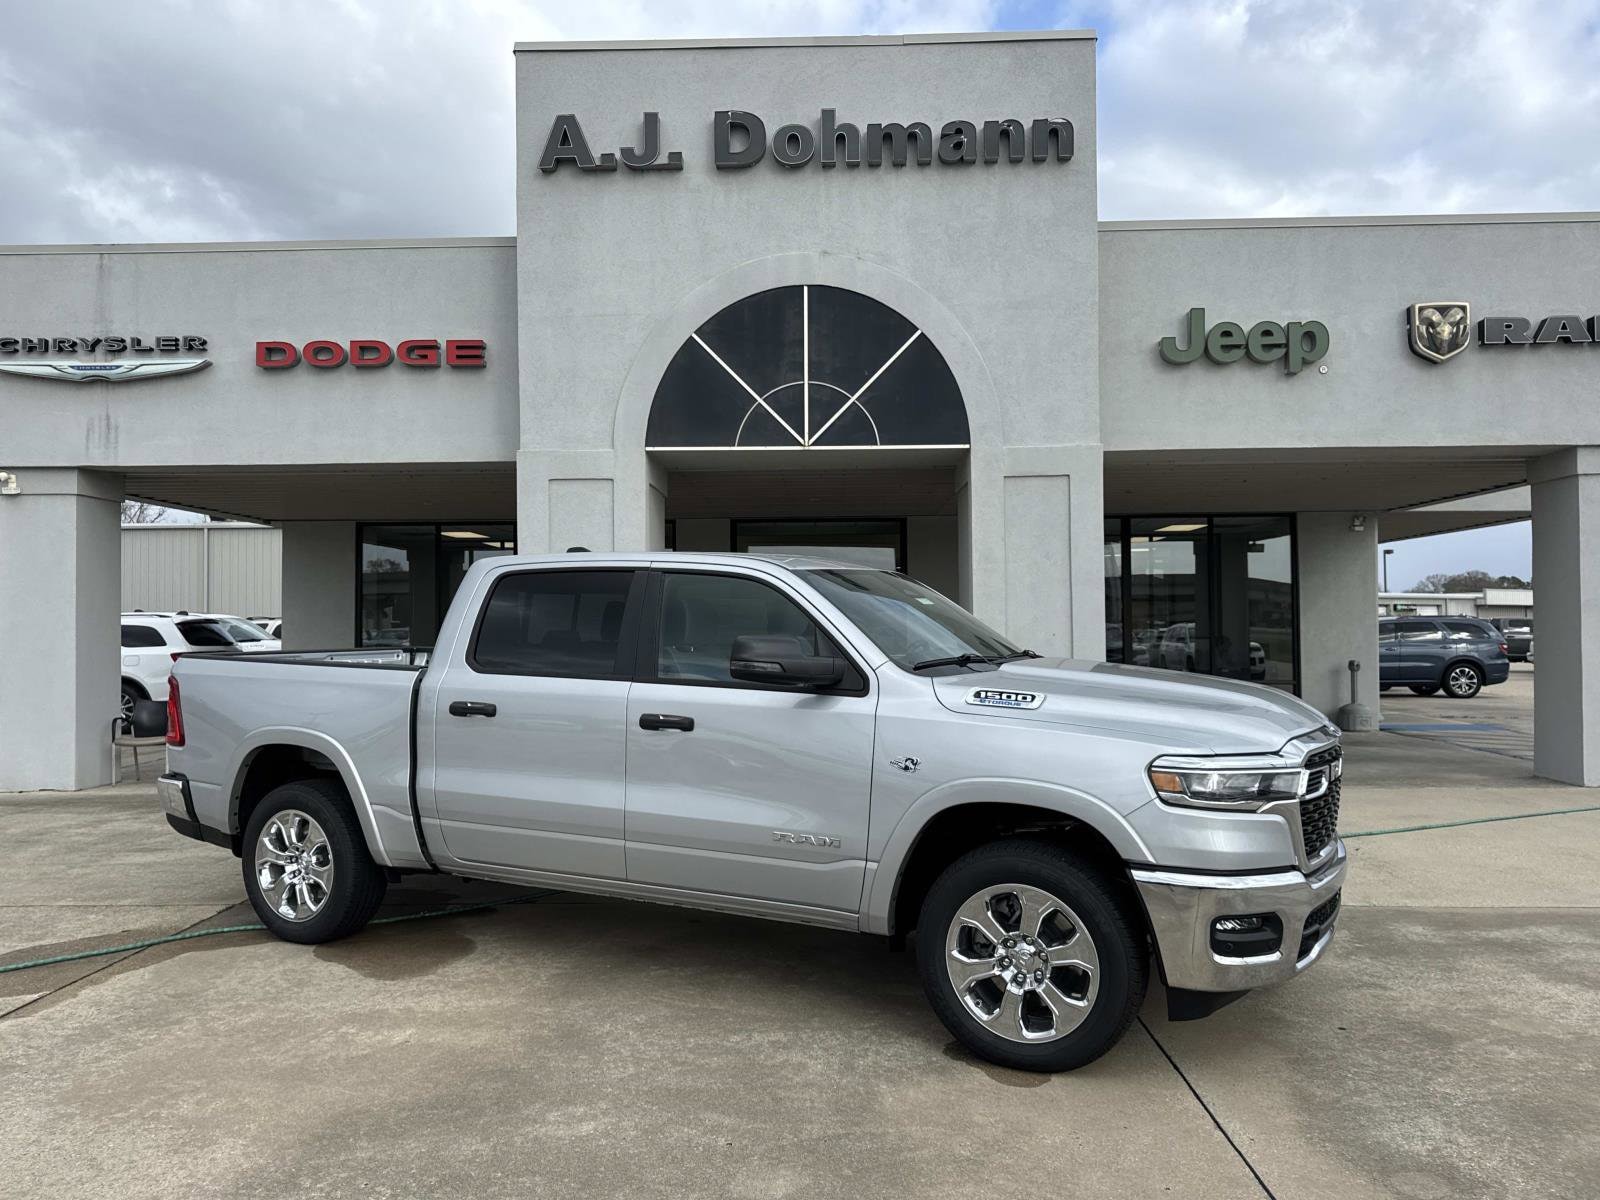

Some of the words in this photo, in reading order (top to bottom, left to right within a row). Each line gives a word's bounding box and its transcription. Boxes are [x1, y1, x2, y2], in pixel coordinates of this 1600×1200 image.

[538, 110, 683, 172] A.J.
[714, 107, 1075, 170] Dohmann
[0, 336, 208, 352] CHRYSLER
[1158, 307, 1330, 376] Jeep
[1478, 315, 1600, 344] RA
[256, 339, 487, 369] DODGE
[979, 691, 1032, 702] 1500
[772, 830, 841, 849] RAM
